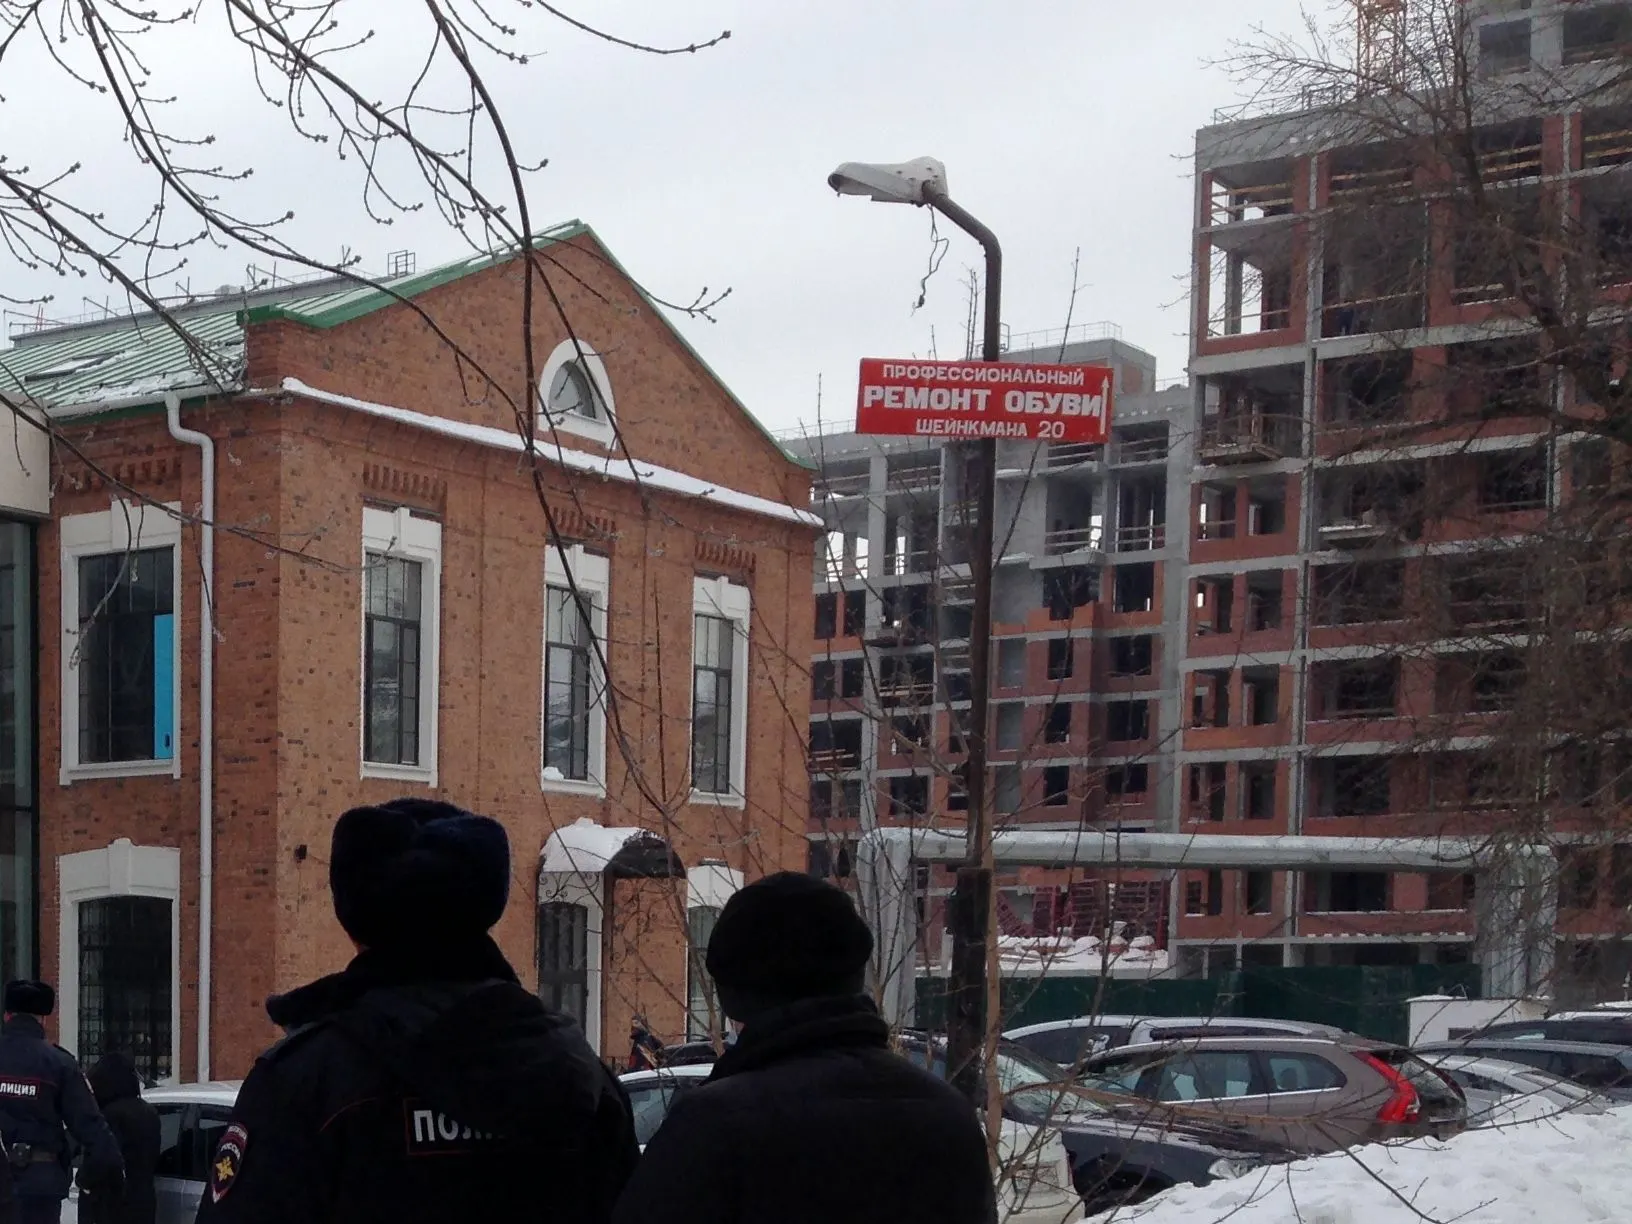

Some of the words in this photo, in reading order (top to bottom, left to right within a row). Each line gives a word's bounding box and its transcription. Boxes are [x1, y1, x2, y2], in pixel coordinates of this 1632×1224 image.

[883, 363, 1085, 386] ПРОФЕССИОНАЛЬНЫЙ
[863, 385, 992, 411] РЕМОНТ
[1004, 390, 1102, 417] ОБУВИ
[916, 418, 1028, 437] ШЕЙНКМАНА
[1037, 420, 1065, 439] 20
